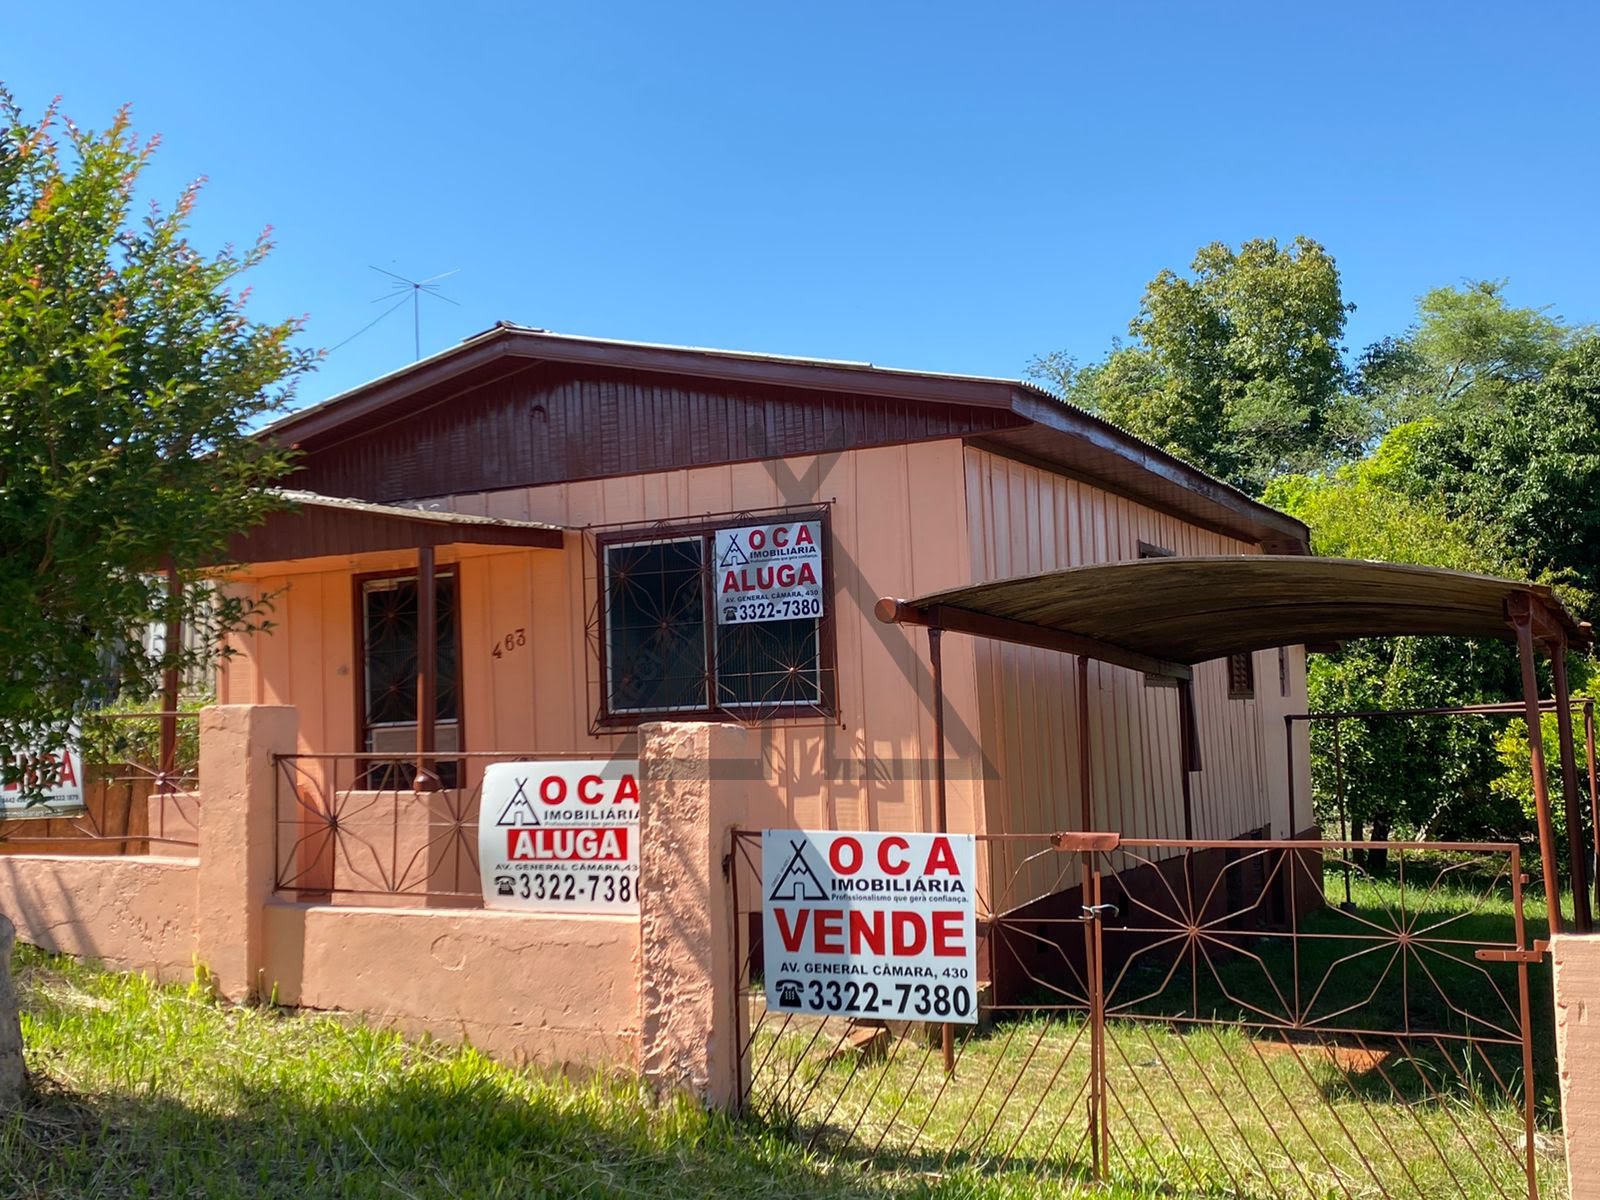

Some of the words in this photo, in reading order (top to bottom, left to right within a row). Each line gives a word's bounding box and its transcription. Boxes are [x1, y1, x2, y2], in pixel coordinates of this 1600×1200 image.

[748, 524, 814, 550] OCA
[722, 562, 817, 594] ALUGA
[737, 594, 769, 602] GENERAL
[740, 598, 820, 621] 3322-7380
[492, 628, 526, 659] 463
[539, 774, 640, 805] OCA
[512, 829, 622, 859] ALUGA
[828, 836, 960, 876] OCA
[830, 892, 892, 902] Profissionalismo
[893, 894, 907, 904] que
[909, 895, 926, 904] gera
[928, 894, 968, 904] confiança.
[831, 876, 965, 892] IMOBILIÁRIA
[773, 908, 967, 957] VENDE
[780, 962, 800, 972] AV.
[804, 962, 868, 976] GENERAL
[872, 963, 938, 980] CÂMARA,
[942, 967, 968, 979] 430
[808, 980, 970, 1017] 3322-7380
